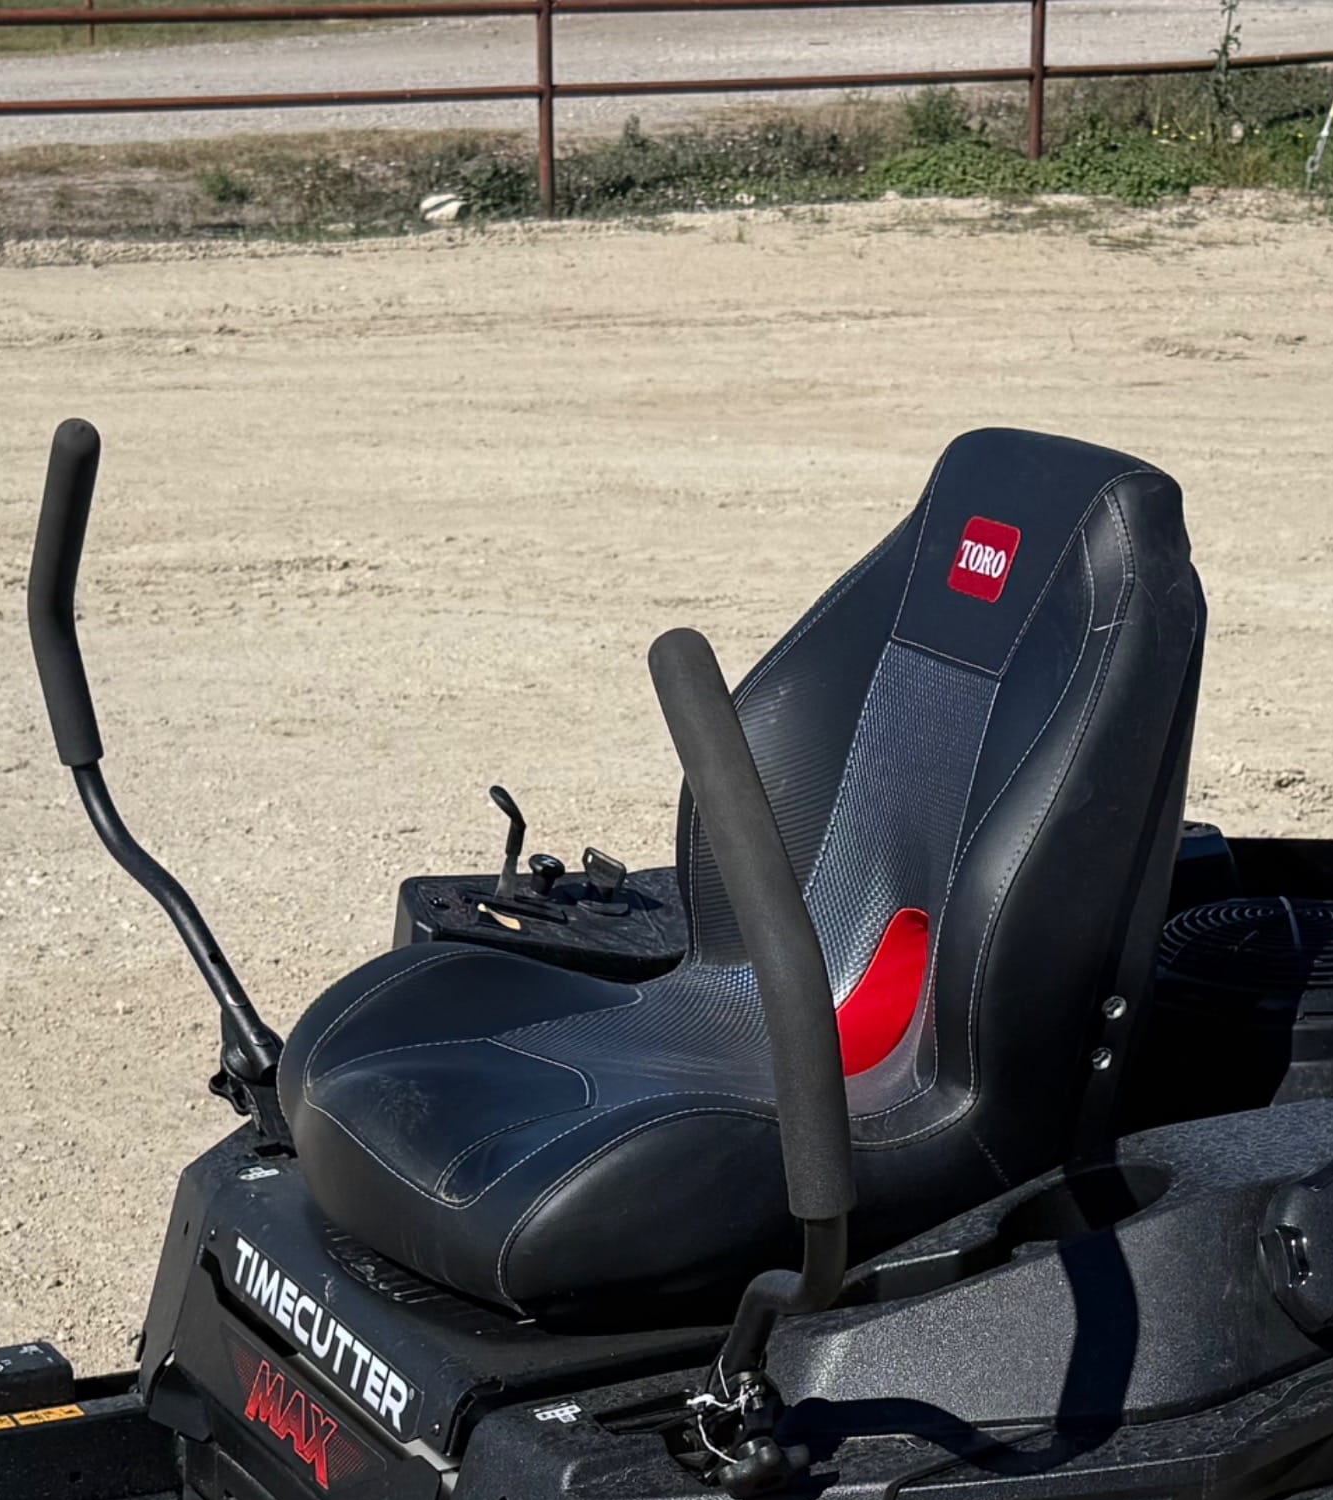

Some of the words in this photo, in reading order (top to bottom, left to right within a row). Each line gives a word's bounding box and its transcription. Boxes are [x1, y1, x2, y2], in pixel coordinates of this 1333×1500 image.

[957, 540, 1007, 579] TORO
[236, 1237, 408, 1433] TIMECUTTER
[244, 1360, 338, 1489] MAX
